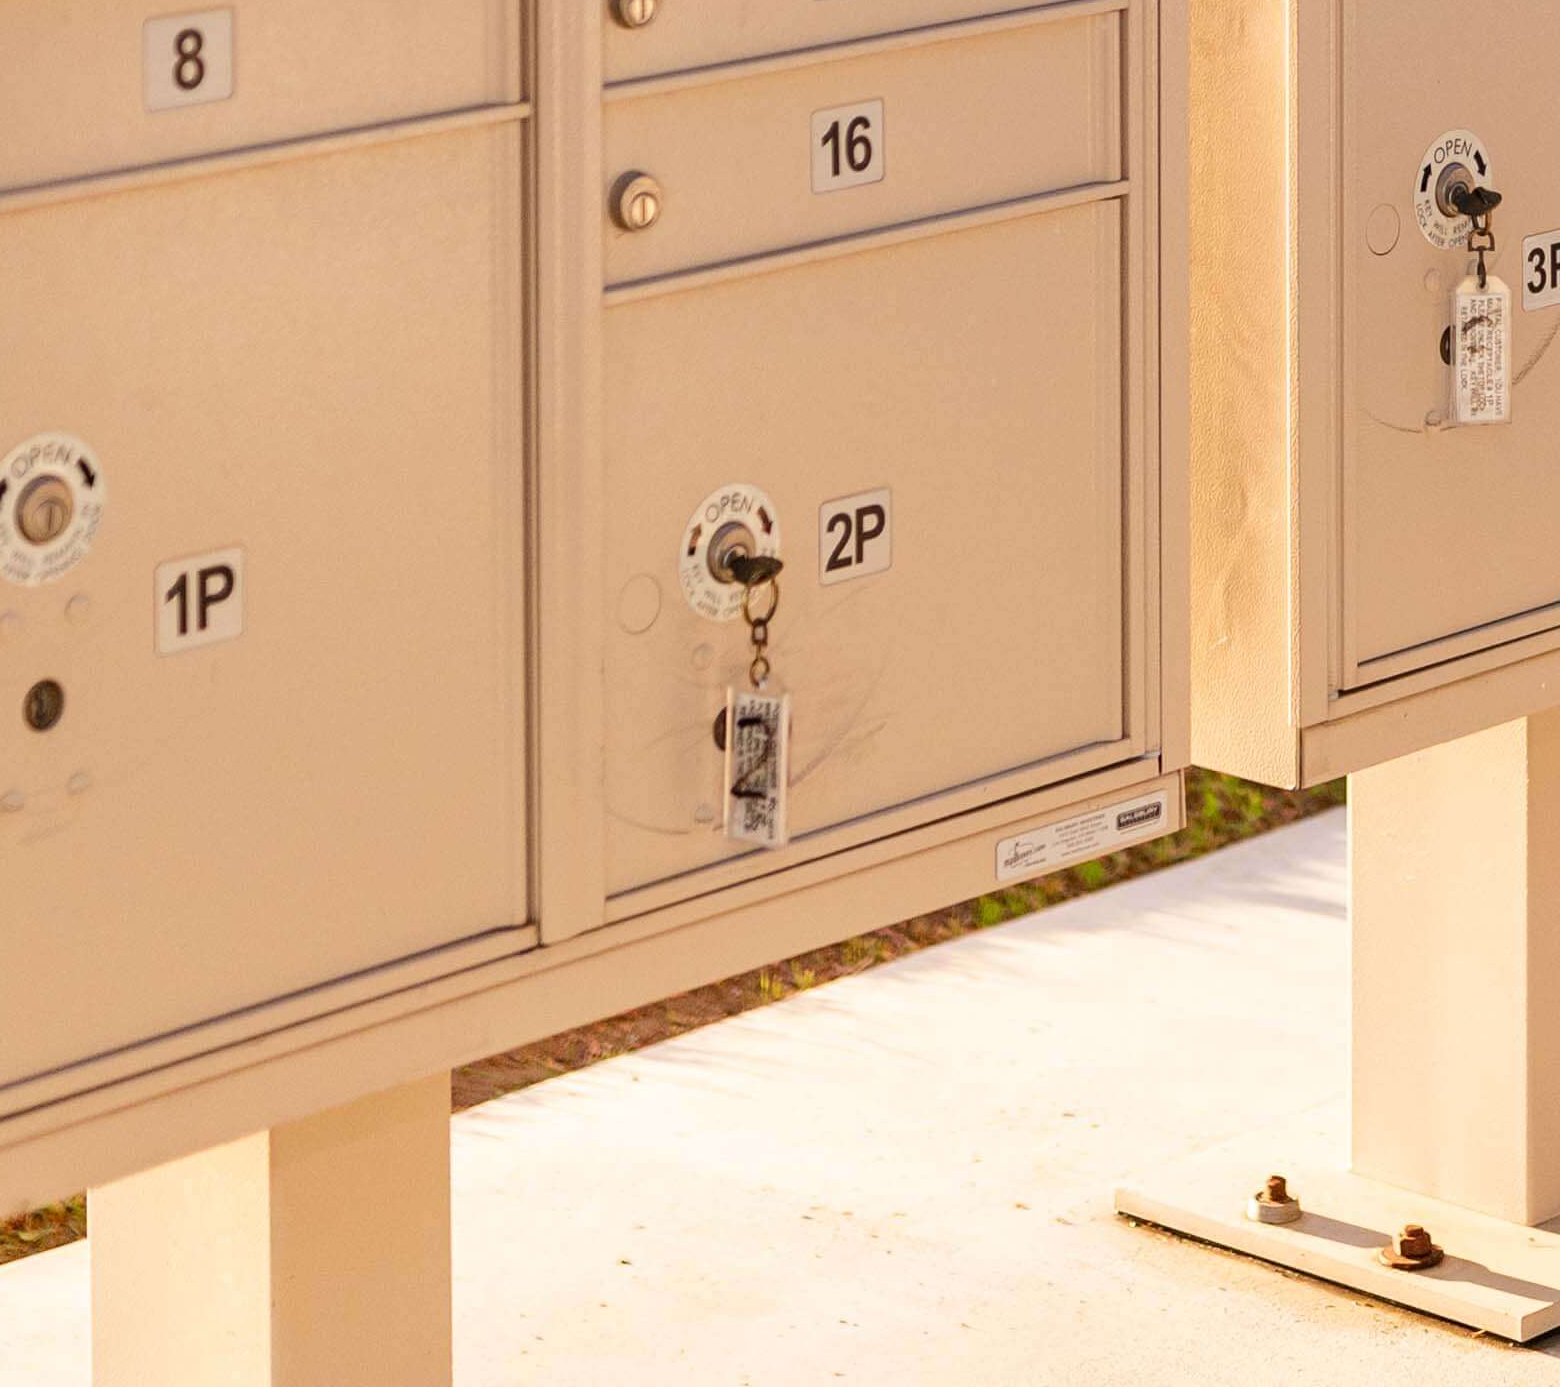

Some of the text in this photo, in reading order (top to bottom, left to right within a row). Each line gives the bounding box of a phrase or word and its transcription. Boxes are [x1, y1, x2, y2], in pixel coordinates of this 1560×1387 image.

[174, 28, 205, 91] 8
[821, 116, 872, 177] 16
[1433, 138, 1473, 165] OPEN
[10, 442, 72, 479] OPEN
[704, 491, 754, 524] OPEN
[825, 504, 886, 572] 2P
[166, 564, 235, 635] 1P
